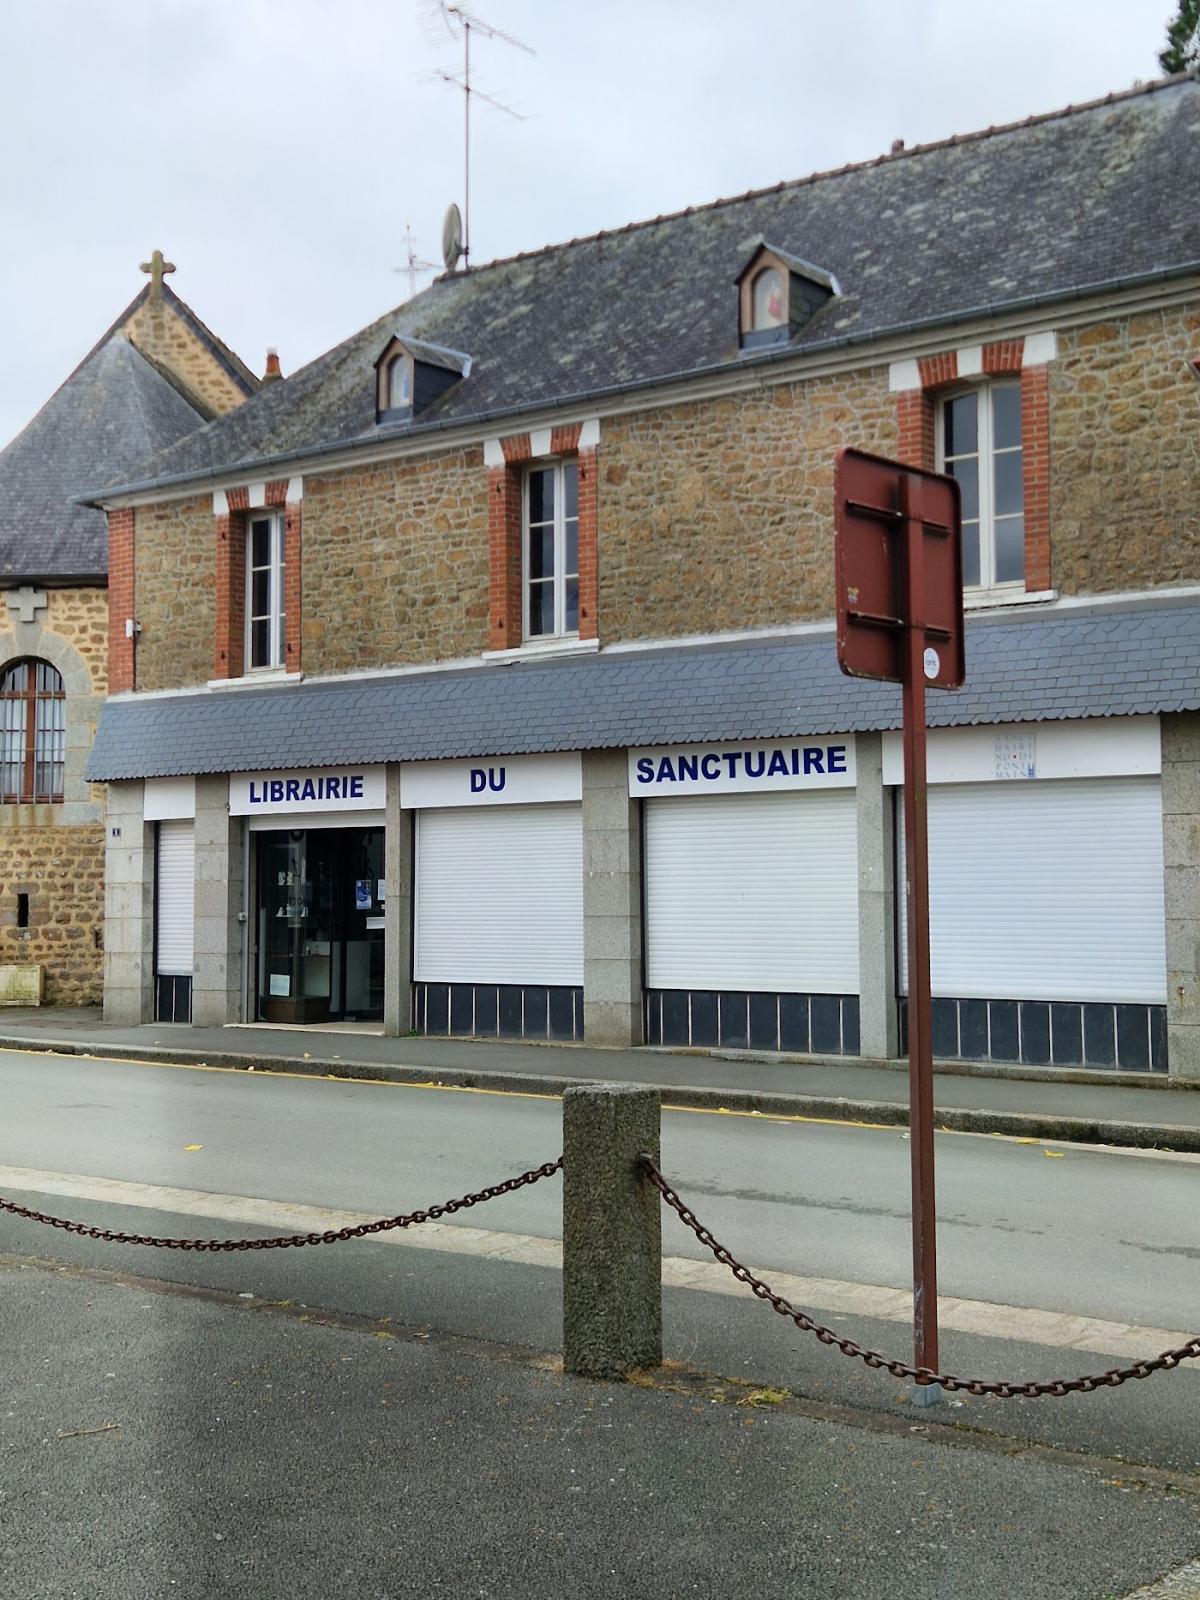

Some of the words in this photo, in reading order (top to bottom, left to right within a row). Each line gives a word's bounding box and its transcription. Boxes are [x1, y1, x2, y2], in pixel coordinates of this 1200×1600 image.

[249, 777, 363, 804] LIBRAIRIE
[470, 768, 506, 793] DU
[636, 747, 847, 784] SANCTUAIRE
